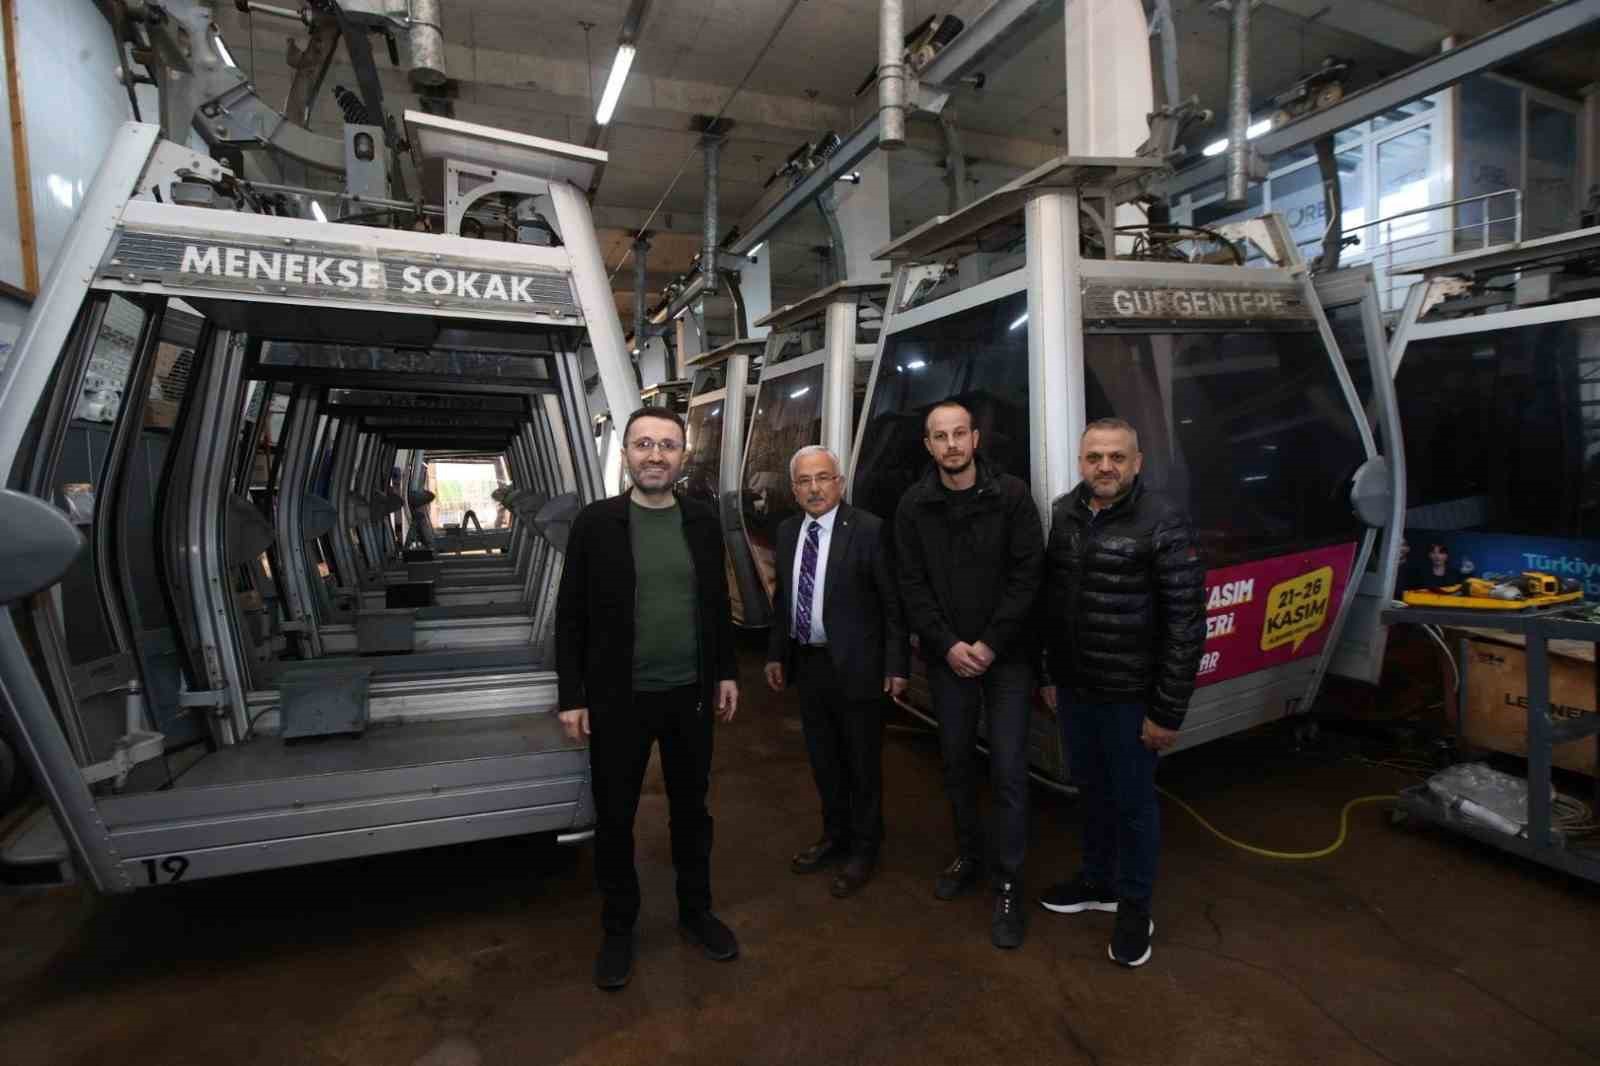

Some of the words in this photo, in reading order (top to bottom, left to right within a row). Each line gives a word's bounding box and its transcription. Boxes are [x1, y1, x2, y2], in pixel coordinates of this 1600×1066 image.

[401, 265, 535, 303] SOKAK
[1205, 578, 1255, 611] ASIM
[1266, 598, 1327, 634] KASIM
[140, 855, 190, 884] 19
